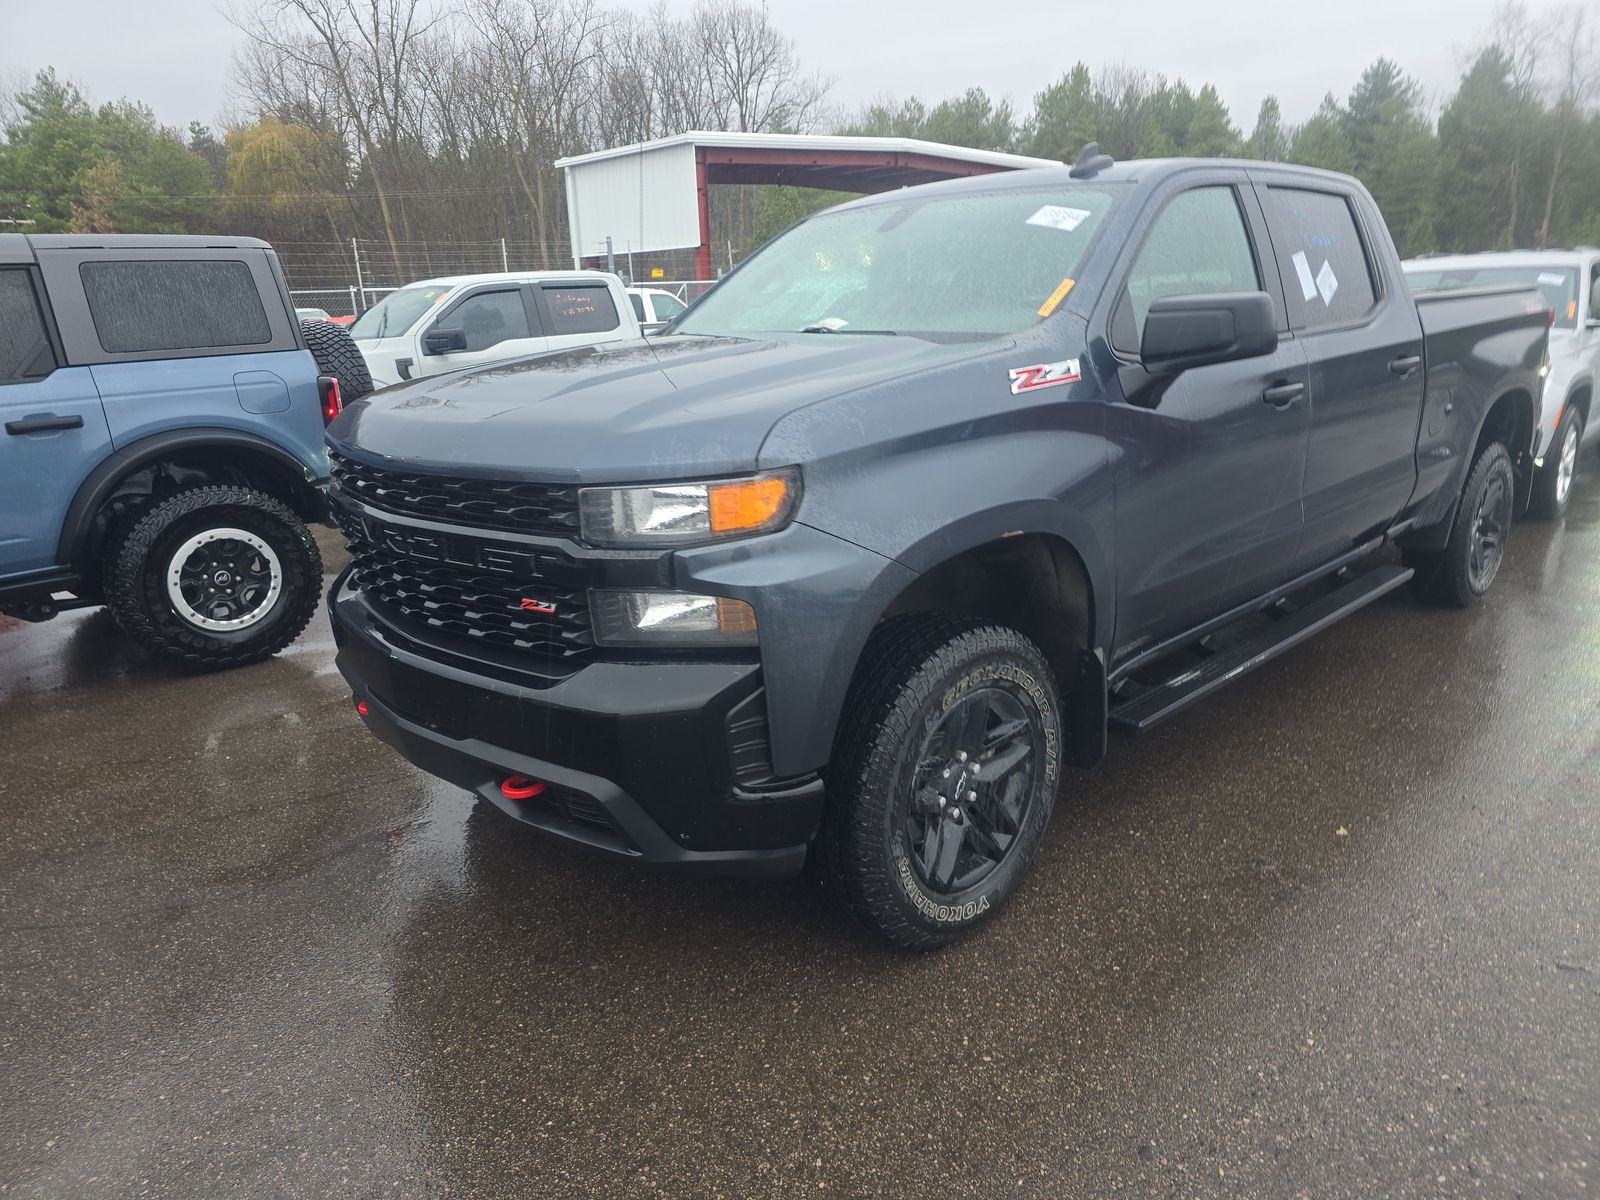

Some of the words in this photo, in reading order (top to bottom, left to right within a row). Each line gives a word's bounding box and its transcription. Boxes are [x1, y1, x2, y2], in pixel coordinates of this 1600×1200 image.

[1008, 357, 1082, 395] Z71
[520, 597, 558, 614] Z71
[941, 664, 1051, 720] GEOLANDAR
[1045, 728, 1058, 781] A/T
[897, 856, 991, 922] YOKOHAMA
